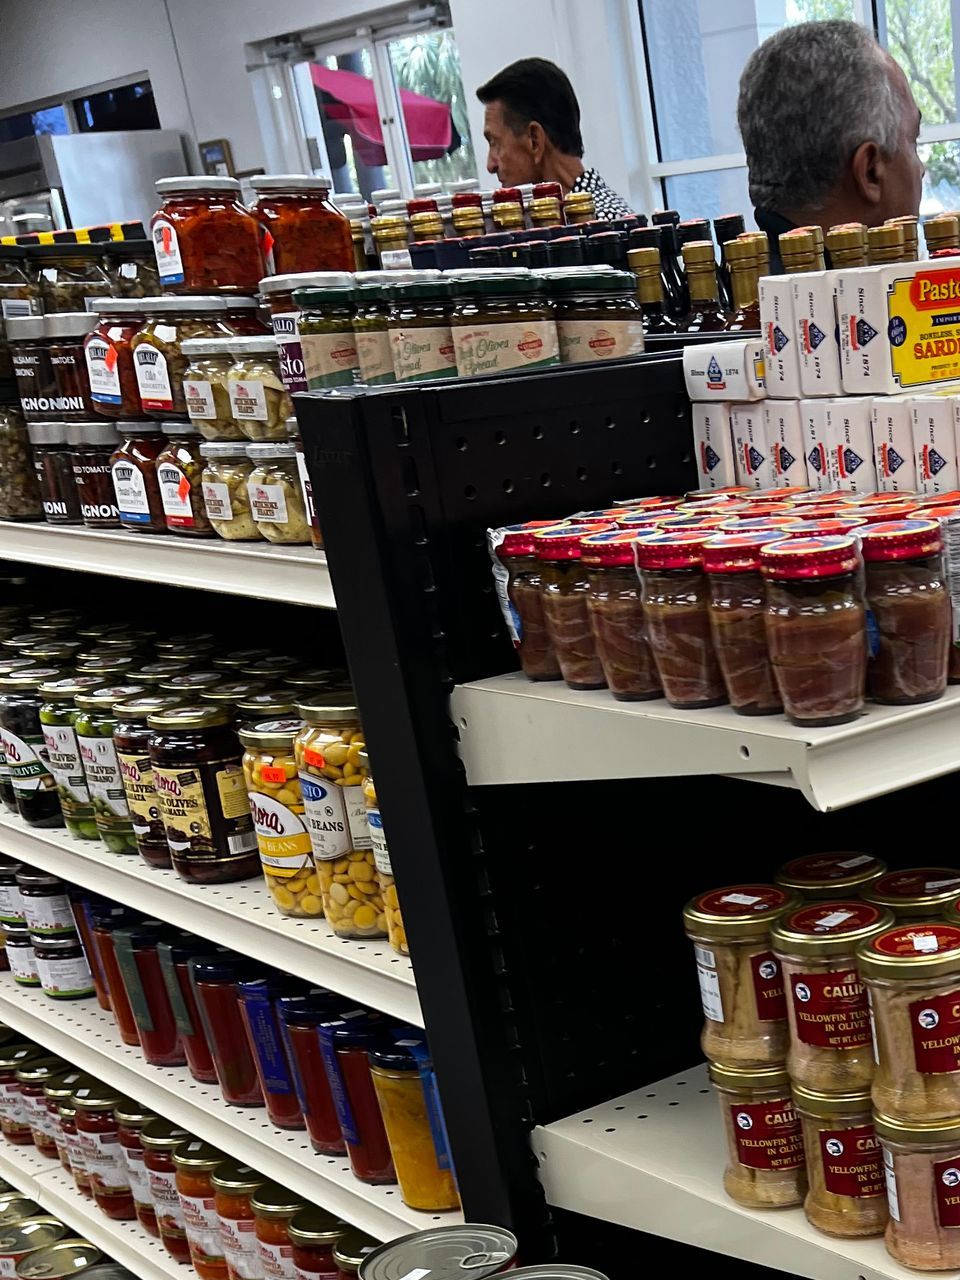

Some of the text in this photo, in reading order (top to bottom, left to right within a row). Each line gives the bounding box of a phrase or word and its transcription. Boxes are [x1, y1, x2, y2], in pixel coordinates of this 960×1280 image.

[862, 353, 870, 377] 1874
[88, 765, 117, 776] OLIVES
[166, 799, 199, 810] OLIVES
[312, 818, 345, 833] BEANS
[266, 839, 298, 853] BEANS
[799, 1011, 847, 1024] YELLOWFIN
[825, 1020, 866, 1032] IN OLIVE
[740, 1137, 787, 1149] YELLOWFIN
[829, 1162, 878, 1175] YELLOWFIN
